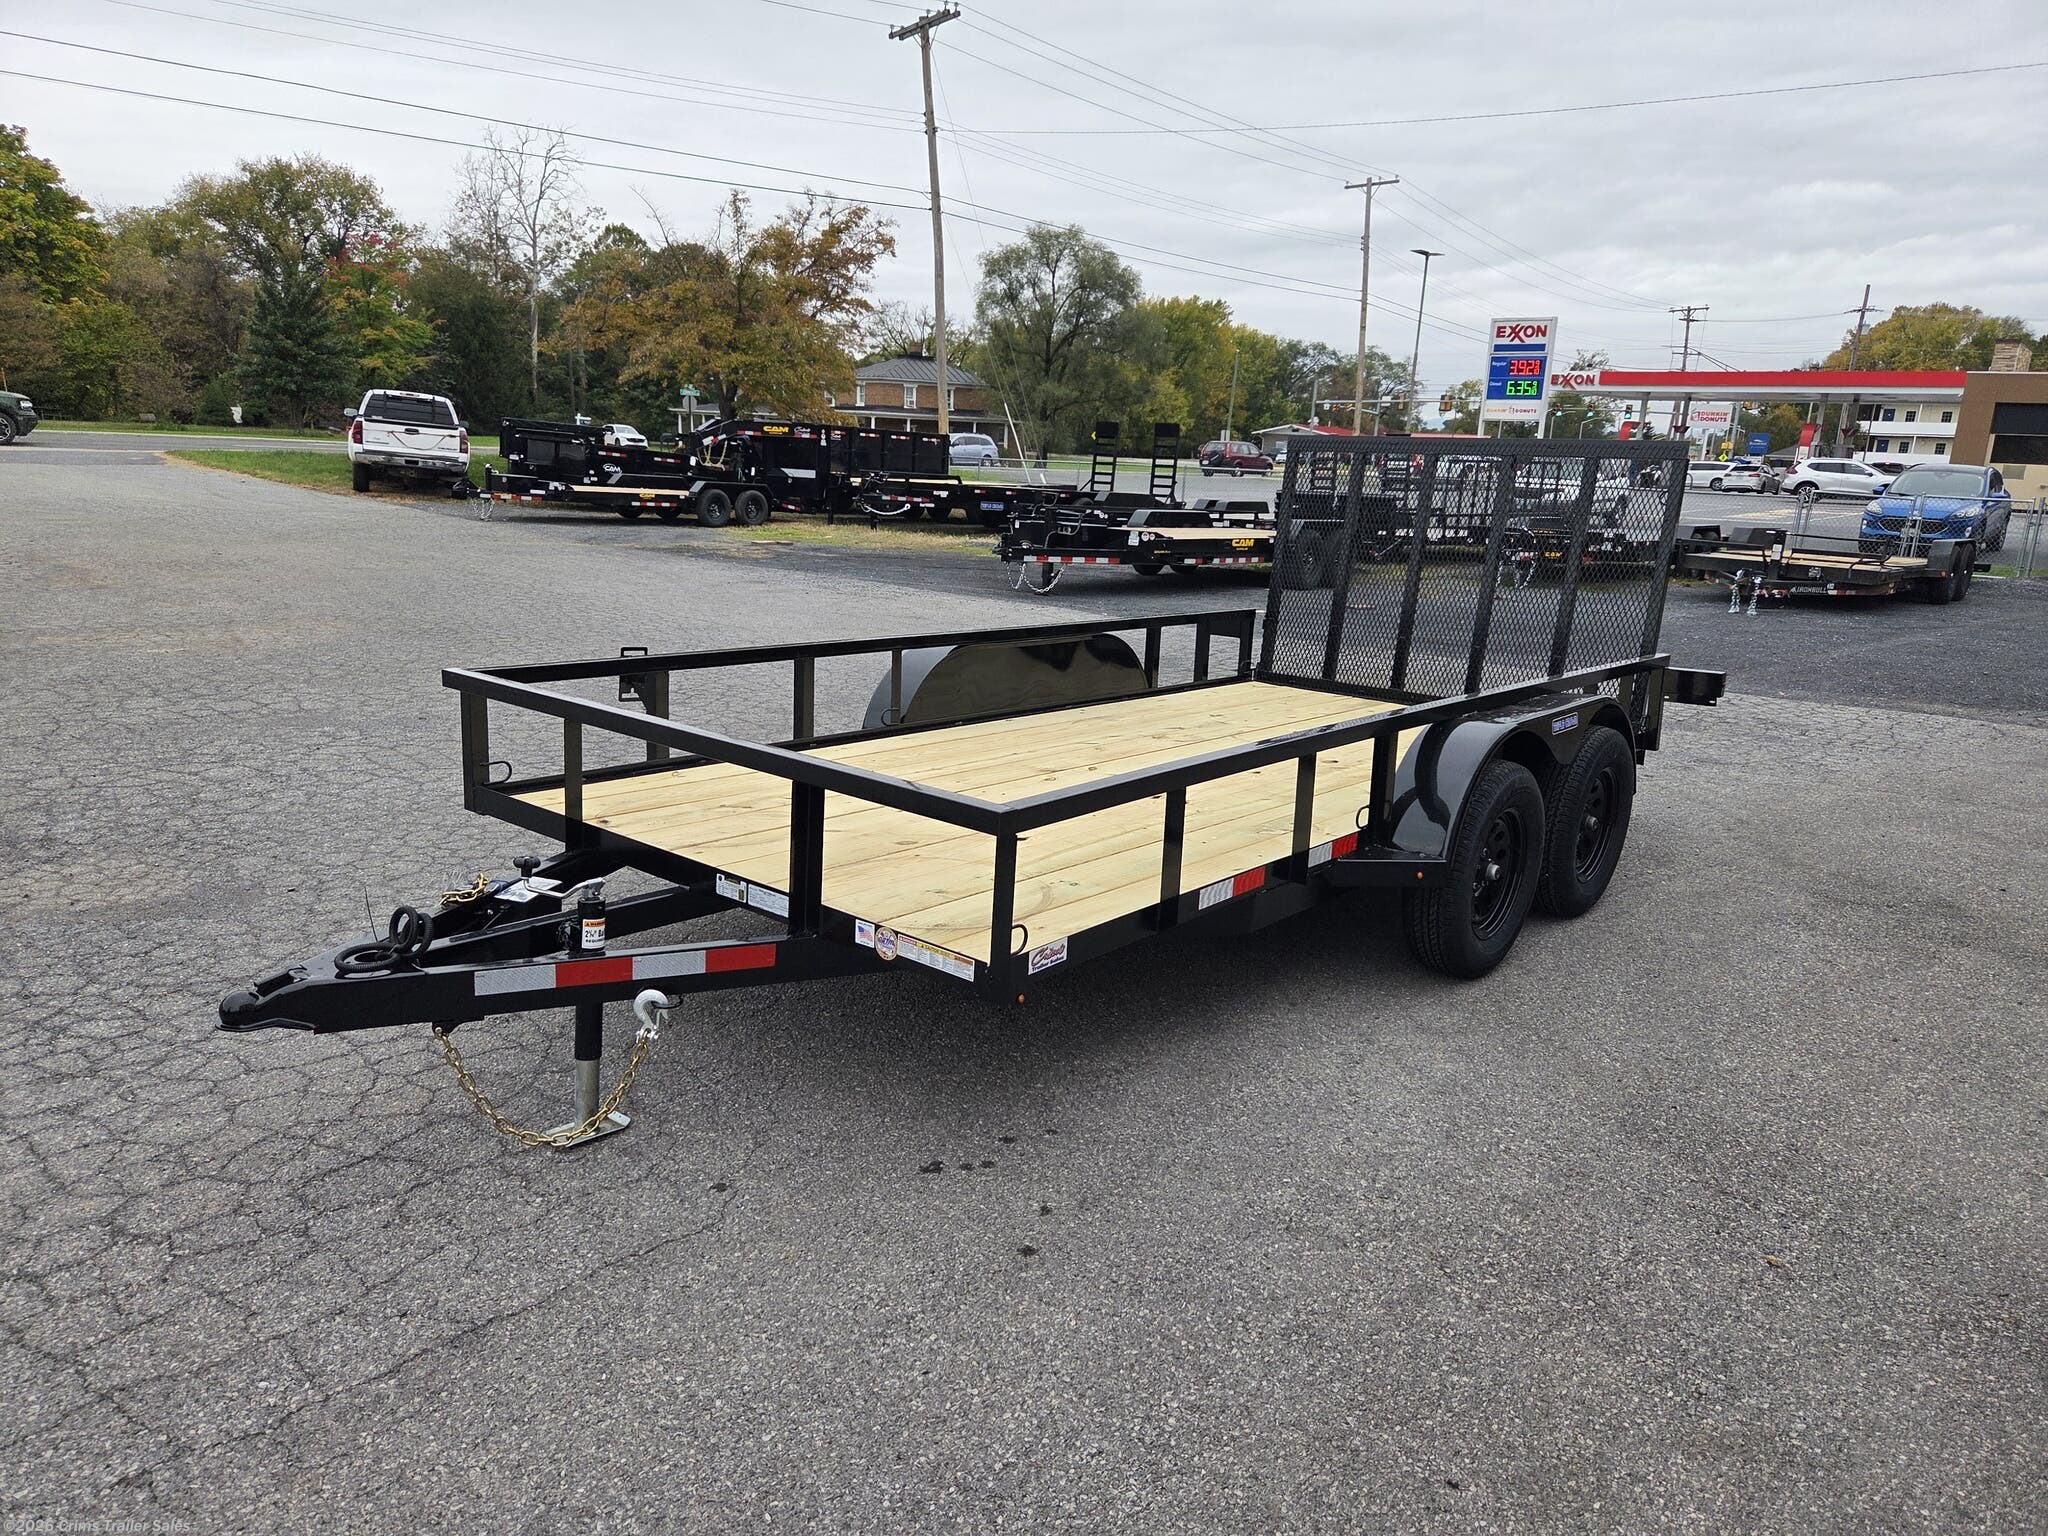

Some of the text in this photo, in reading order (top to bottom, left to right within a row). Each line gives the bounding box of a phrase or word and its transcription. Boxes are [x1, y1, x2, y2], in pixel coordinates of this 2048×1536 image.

[1495, 323, 1548, 343] EXXON
[1550, 373, 1596, 390] EXXON
[763, 425, 789, 433] CAM
[1231, 539, 1255, 547] CAM
